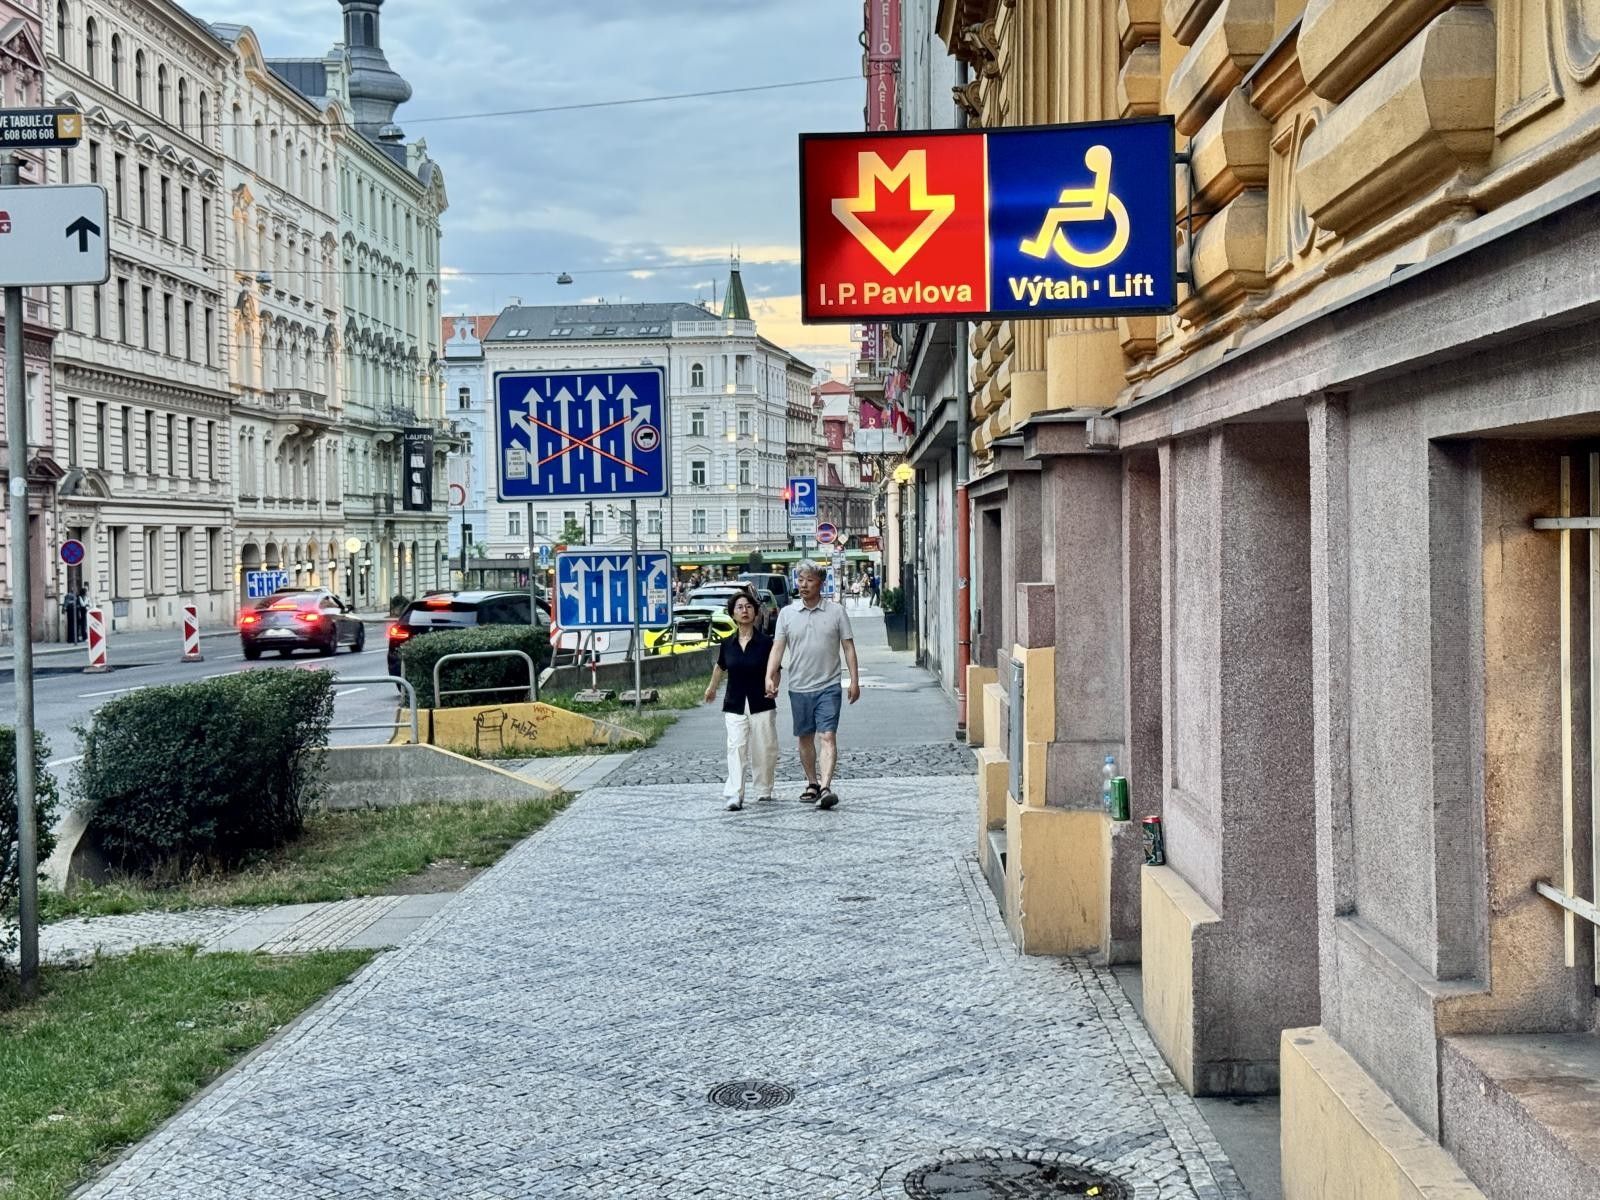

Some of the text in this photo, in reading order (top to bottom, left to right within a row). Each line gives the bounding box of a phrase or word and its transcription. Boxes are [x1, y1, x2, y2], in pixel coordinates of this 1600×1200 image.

[10, 115, 53, 127] TABULE.CZ
[4, 128, 55, 140] 608 608 608
[863, 281, 972, 304] Pavlova
[1008, 273, 1154, 306] Výtah Lift
[795, 482, 811, 505] P
